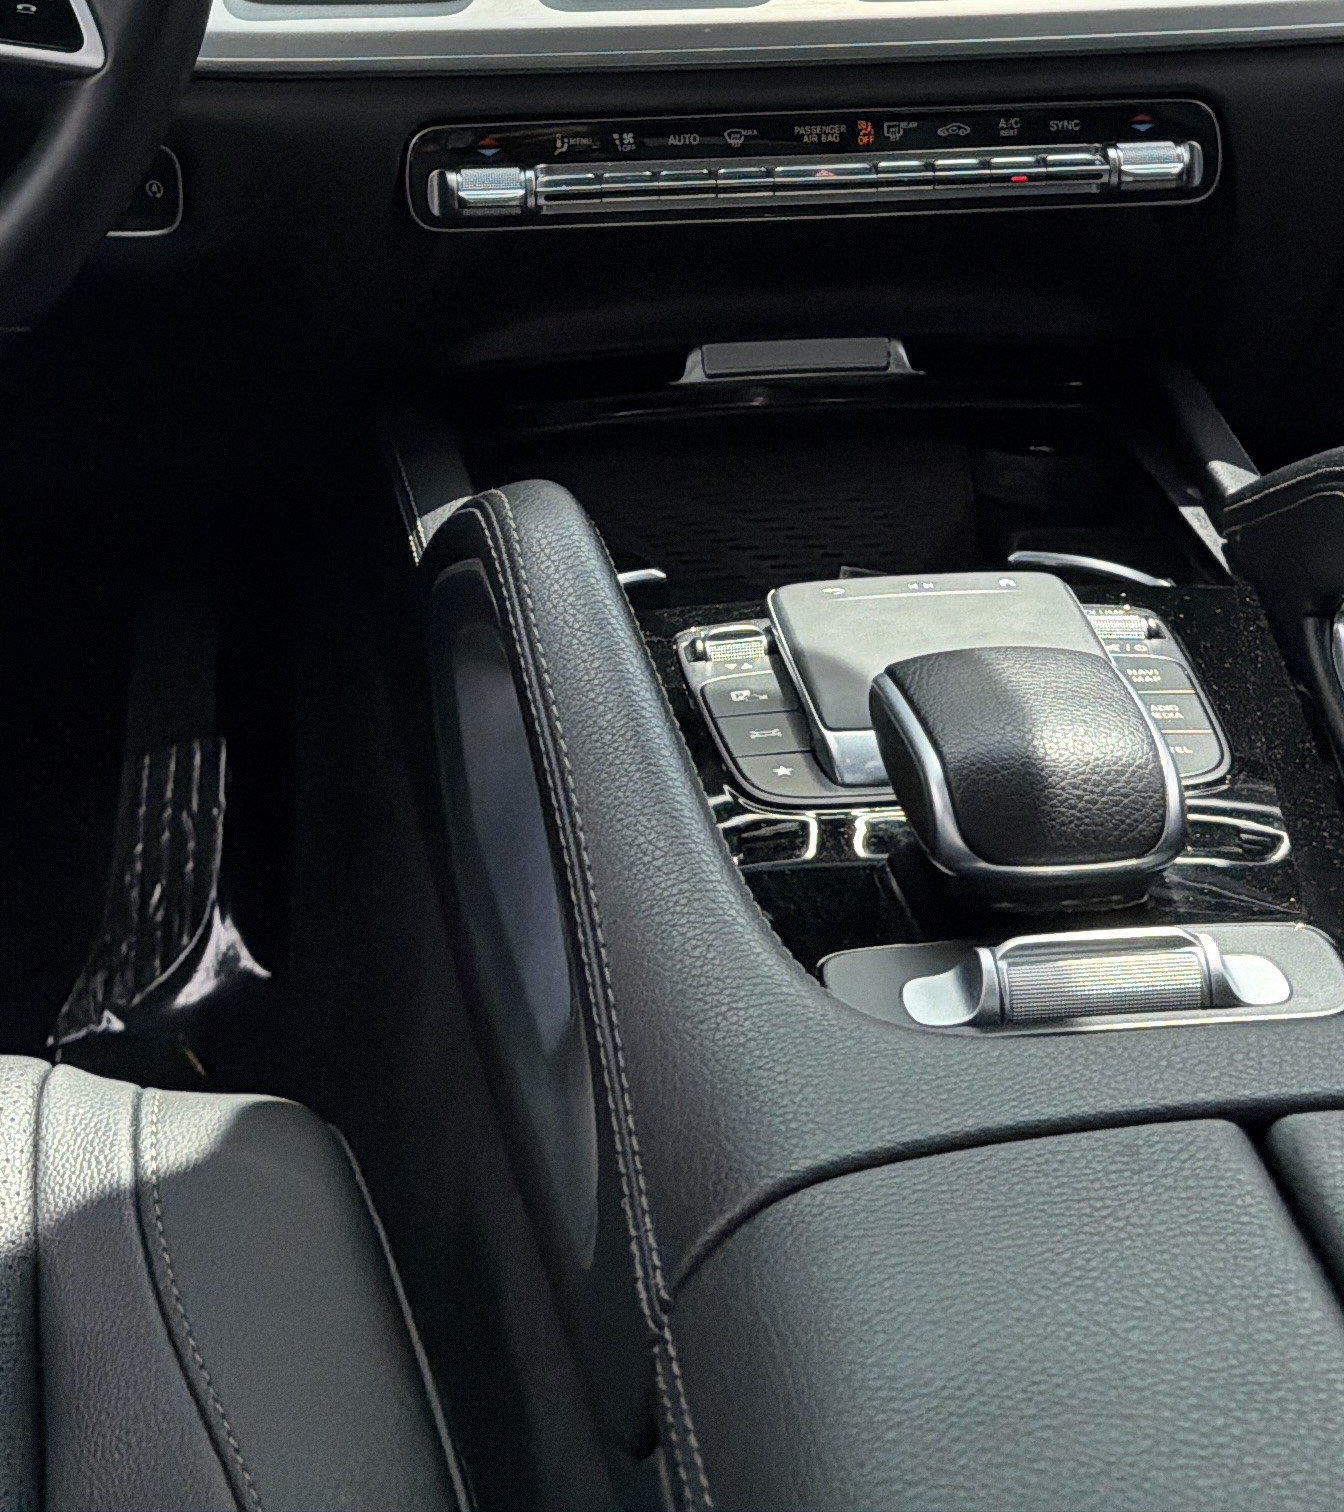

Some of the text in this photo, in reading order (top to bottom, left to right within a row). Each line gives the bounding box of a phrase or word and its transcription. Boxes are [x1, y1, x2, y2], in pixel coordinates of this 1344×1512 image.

[998, 117, 1021, 128] A/C
[1049, 119, 1081, 132] SYNC
[794, 124, 847, 135] PASSENGER
[668, 133, 700, 146] AUTO
[802, 133, 840, 143] AIR BAG
[857, 135, 875, 146] OFF
